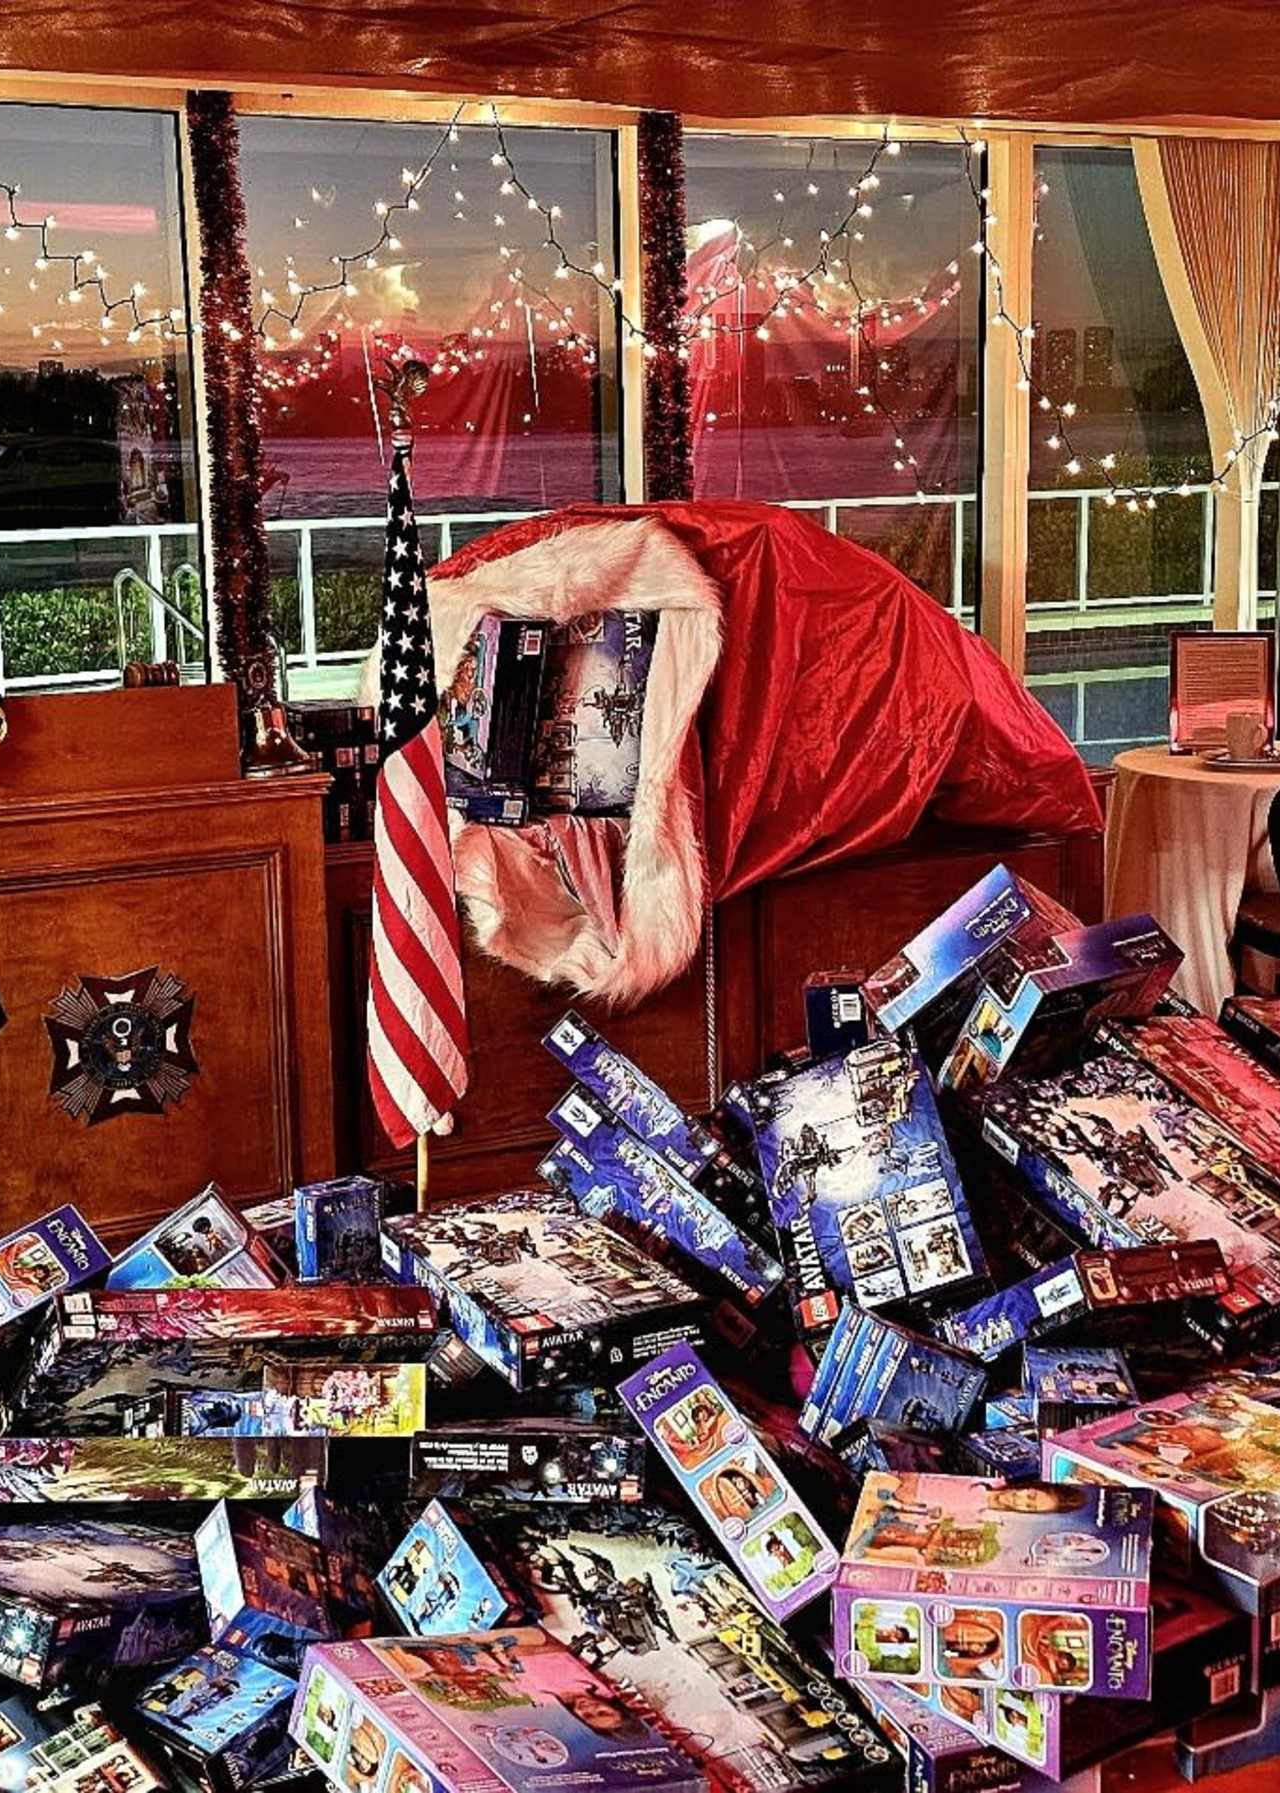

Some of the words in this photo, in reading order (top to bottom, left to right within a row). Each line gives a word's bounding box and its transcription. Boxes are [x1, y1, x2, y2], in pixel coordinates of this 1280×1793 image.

[46, 1218, 90, 1271] ENCANTO
[790, 1216, 826, 1291] AVATAR
[541, 1330, 585, 1349] AVATAR
[635, 1362, 697, 1412] ENCANTO
[957, 1372, 979, 1412] AVATAR
[567, 1483, 618, 1498] AVATAR
[72, 1615, 112, 1635] AVATAR
[1106, 1612, 1127, 1690] ENCANTO
[223, 1751, 245, 1791] AVATAR
